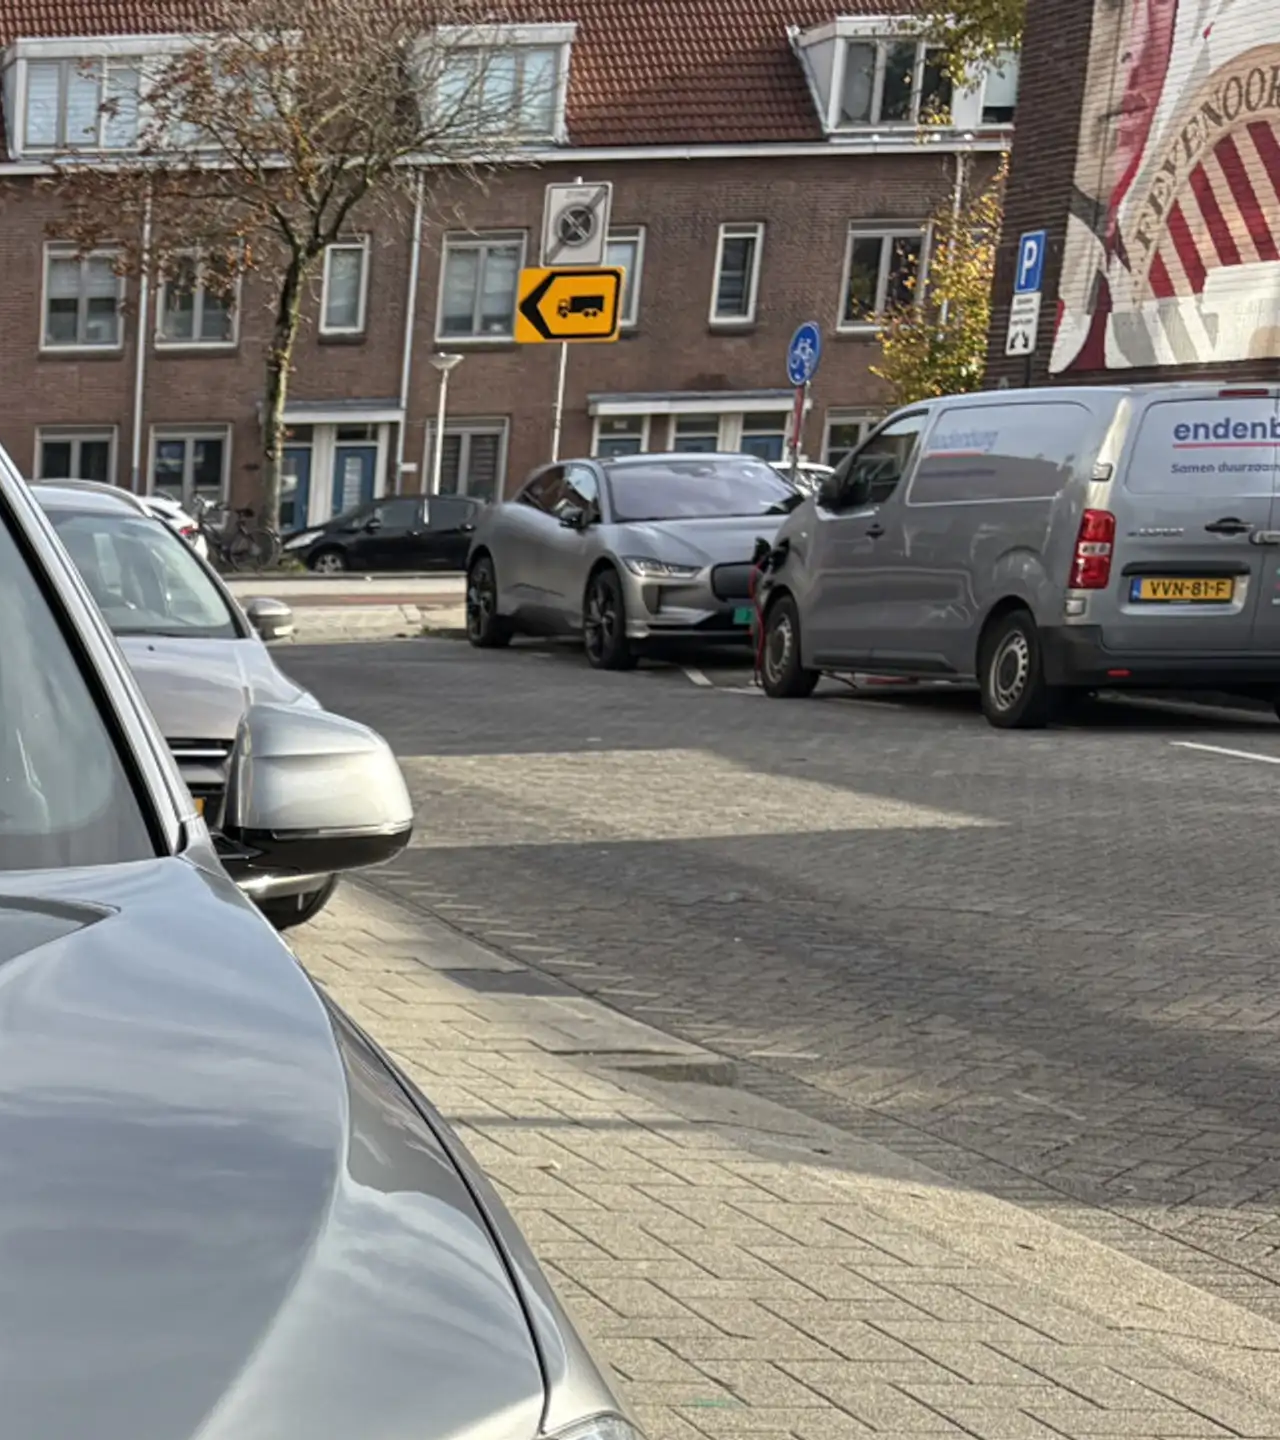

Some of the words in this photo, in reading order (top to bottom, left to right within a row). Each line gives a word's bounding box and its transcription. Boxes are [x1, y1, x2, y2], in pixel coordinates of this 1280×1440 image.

[1020, 240, 1038, 287] P
[1171, 463, 1215, 474] Samen
[1150, 582, 1226, 597] VVN-81-F
